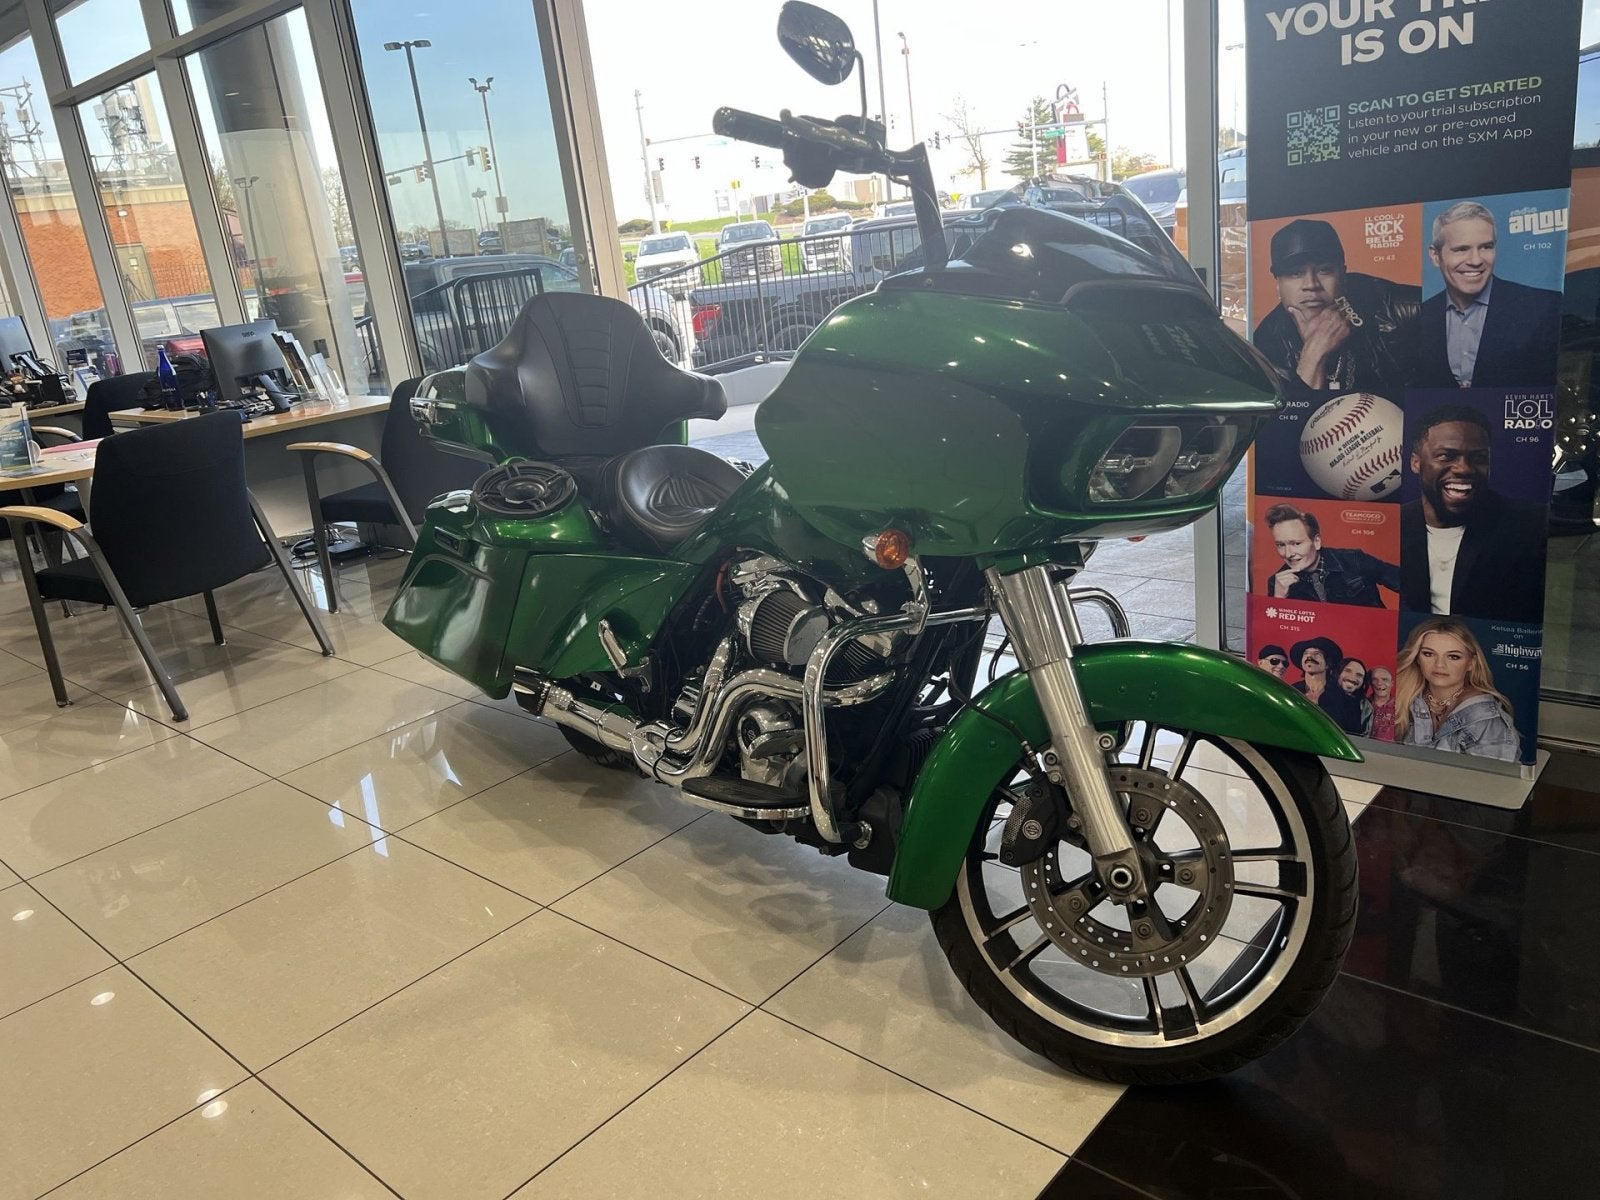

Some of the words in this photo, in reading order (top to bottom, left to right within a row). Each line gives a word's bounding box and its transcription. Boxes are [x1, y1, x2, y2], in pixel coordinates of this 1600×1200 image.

[1265, 0, 1395, 41] YOUR
[1341, 28, 1385, 66] IS
[1398, 12, 1474, 54] ON
[1347, 97, 1392, 115] SCAN
[1396, 93, 1419, 107] TO
[1422, 88, 1456, 103] GET
[1459, 76, 1542, 98] STARTED
[1348, 116, 1384, 129] Listen
[1386, 114, 1399, 123] to
[1401, 110, 1429, 123] your
[1432, 104, 1456, 117] trial
[1458, 94, 1541, 113] subscription
[1348, 134, 1359, 144] in
[1362, 130, 1390, 144] your
[1394, 127, 1420, 137] new
[1424, 124, 1438, 133] or
[1442, 111, 1516, 132] pre-owned
[1348, 144, 1390, 159] vehicle
[1393, 140, 1417, 152] and
[1421, 139, 1438, 149] on
[1442, 135, 1464, 147] the
[1468, 130, 1498, 143] SXM
[1502, 128, 1533, 140] App
[1365, 219, 1404, 236] ROCK
[1374, 213, 1395, 221] COOL
[1365, 234, 1404, 244] BELLS
[1370, 241, 1400, 249] RADIO
[1504, 399, 1554, 419] LOL
[1329, 453, 1346, 468] MAJOR
[1343, 440, 1362, 456] LEAGUE
[1360, 424, 1384, 443] BASEBALL
[1341, 433, 1361, 449] OFFICIAL
[1278, 613, 1296, 621] RED
[1297, 614, 1315, 623] HOT
